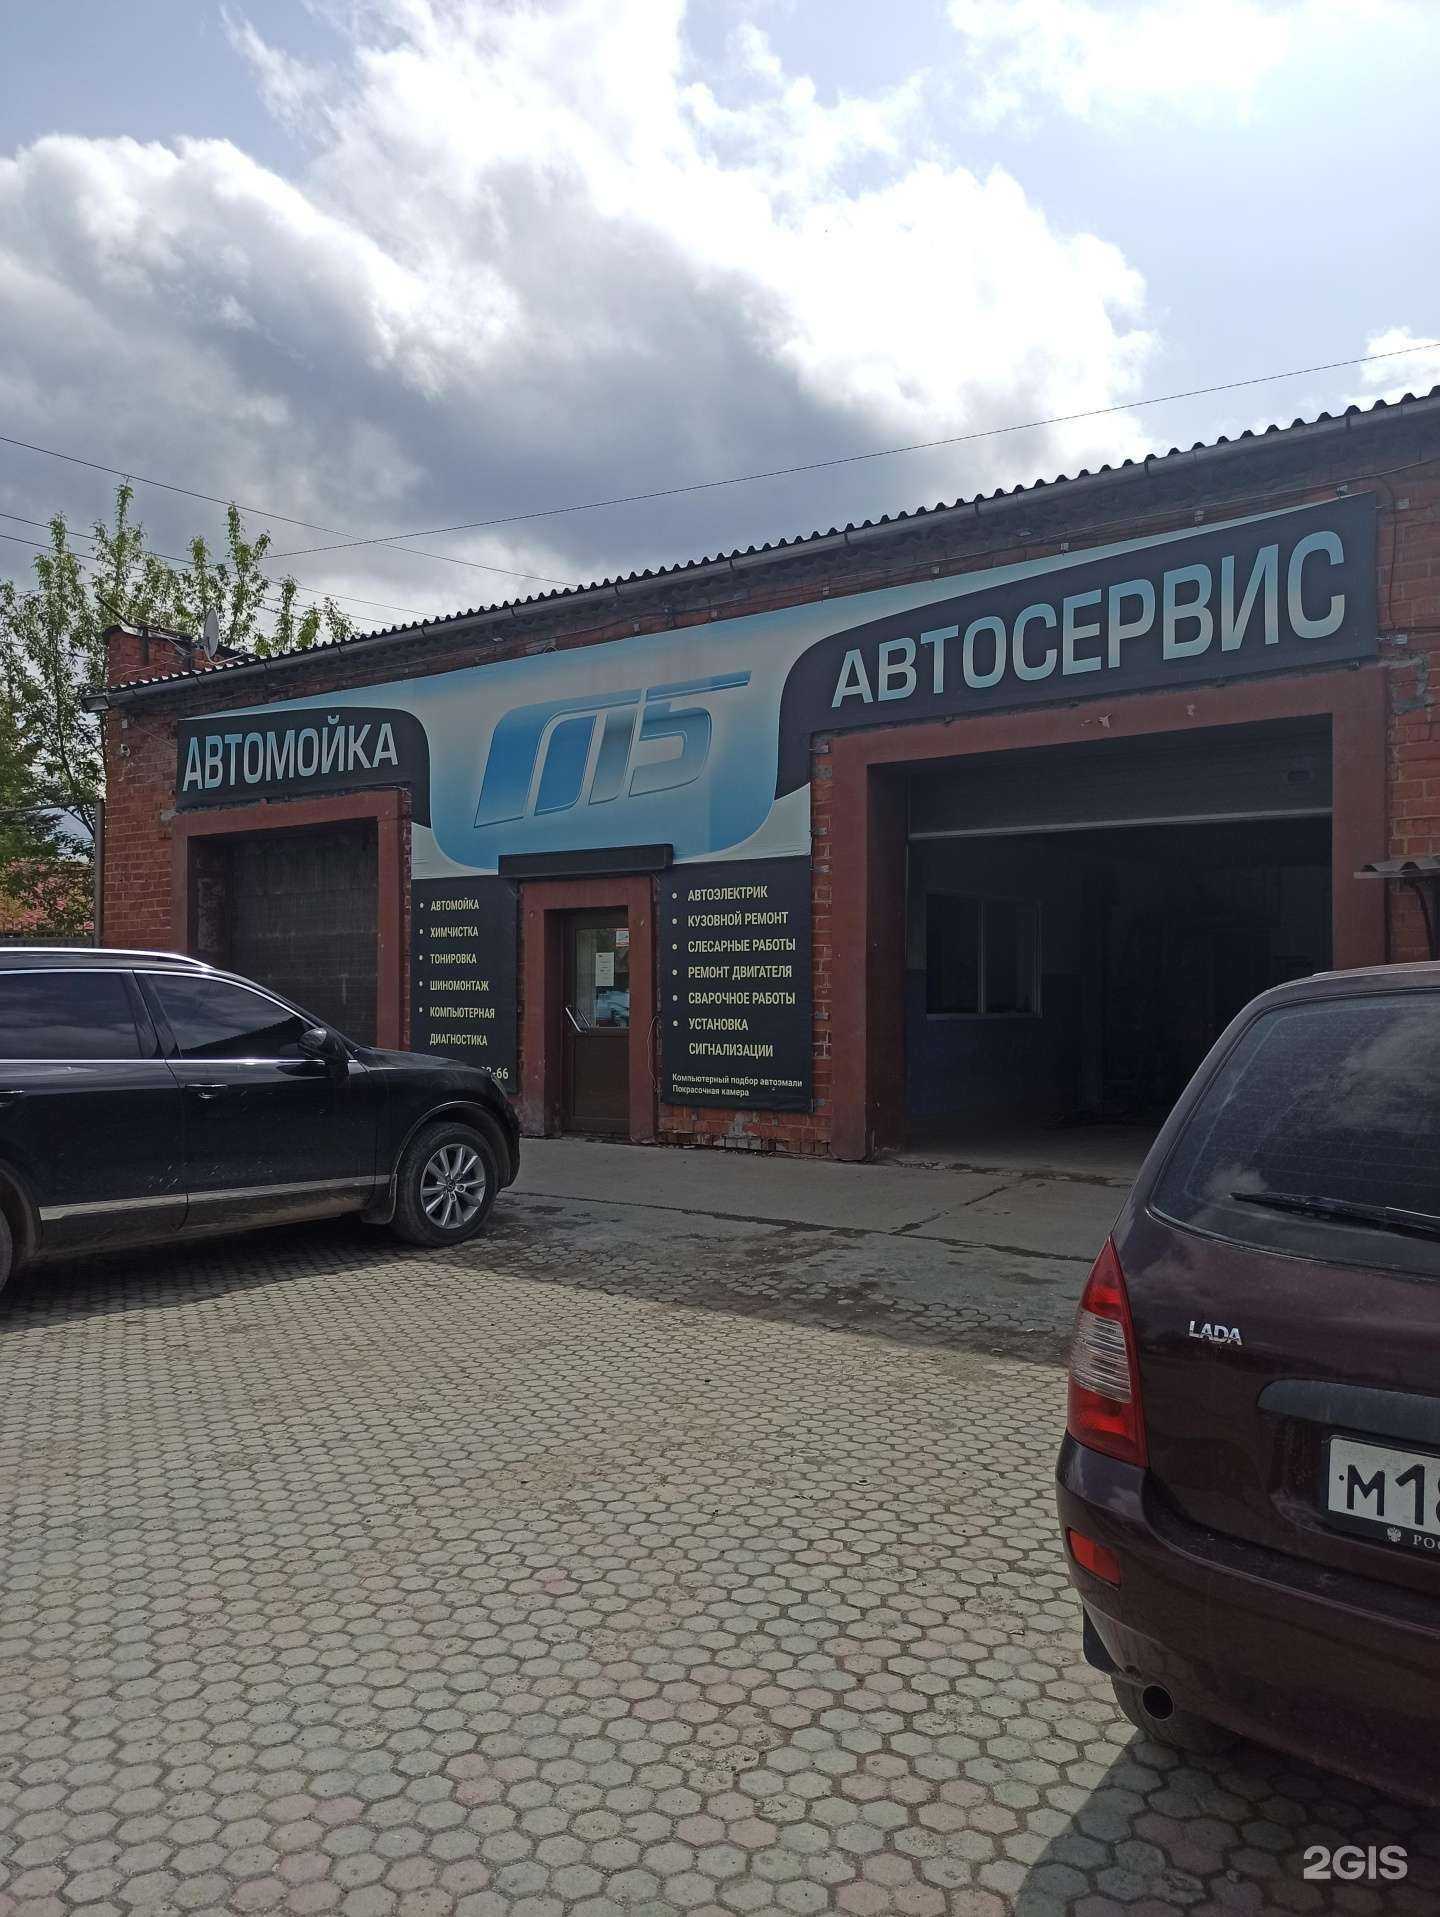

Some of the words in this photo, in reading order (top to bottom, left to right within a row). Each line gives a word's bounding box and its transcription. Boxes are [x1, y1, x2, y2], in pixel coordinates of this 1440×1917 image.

[831, 530, 1345, 708] АВТОСЕРВИС
[182, 714, 399, 792] АВТОМОЙКА
[687, 885, 768, 901] АВТОЭЛЕКТРИК
[430, 897, 480, 911] АВТОМОЙКА
[687, 910, 742, 927] КУЗОВНОЙ
[744, 911, 789, 925] РЕМОНТ
[430, 926, 479, 938] ХИМЧИСТКА
[687, 939, 750, 953] СЛЕСАРНЫЕ
[752, 938, 796, 951] РАБОТЫ
[430, 953, 477, 964] ТОНИРОВКА
[687, 966, 730, 979] РЕМОНТ
[732, 965, 793, 980] ДВИГАТЕЛЯ
[430, 980, 490, 992] ШИНОМОНТАЖ
[688, 992, 750, 1005] СВАРОЧНОЕ
[752, 992, 796, 1005] РАБОТЫ
[429, 1006, 496, 1019] КОМПЬЮТЕРНАЯ
[688, 1018, 749, 1031] УСТАНОВКА
[429, 1033, 488, 1046] ДИАГНОСТИКА
[688, 1042, 774, 1059] СИГНАЛИЗАЦИИ
[672, 1072, 730, 1085] Компьютерный
[730, 1075, 759, 1087] подбор
[672, 1084, 720, 1096] Покрасочная
[721, 1087, 750, 1098] камера
[1188, 1320, 1243, 1346] LADA
